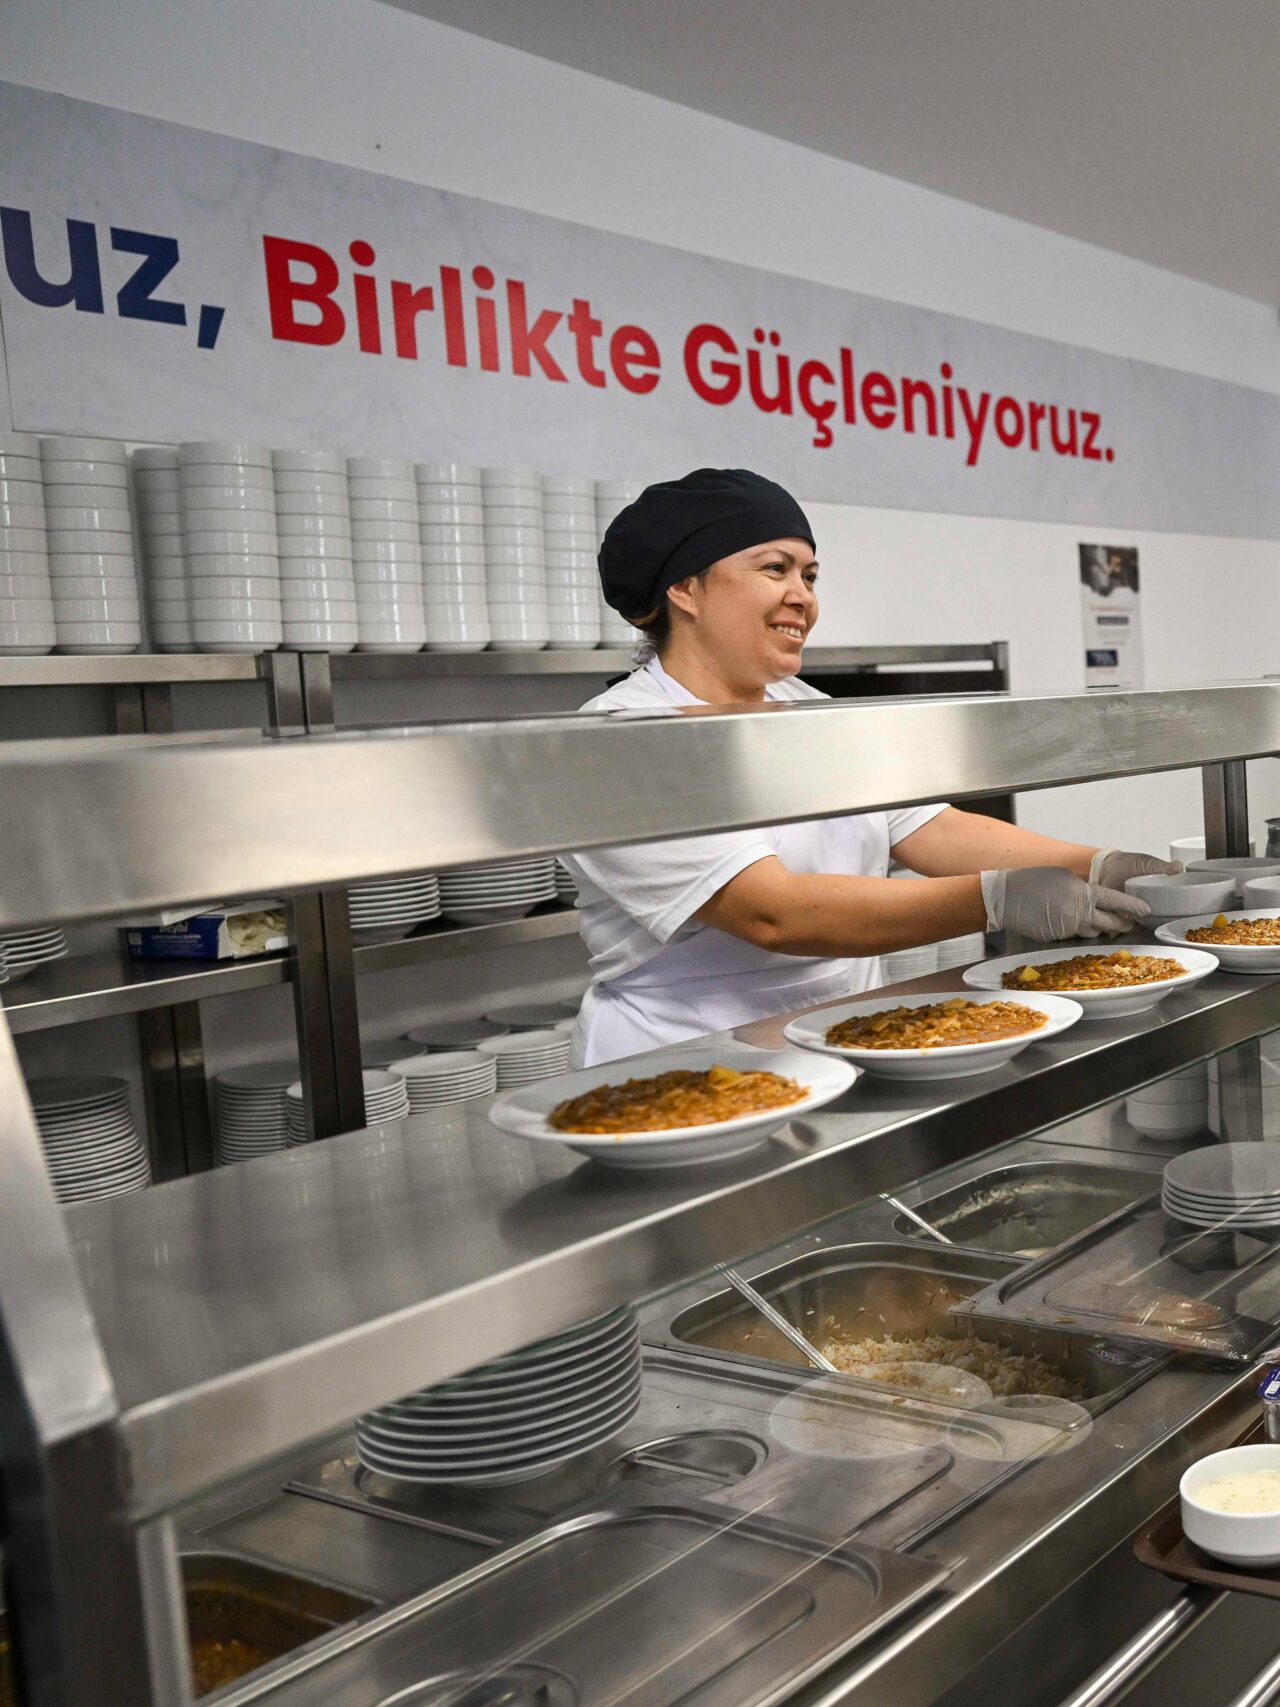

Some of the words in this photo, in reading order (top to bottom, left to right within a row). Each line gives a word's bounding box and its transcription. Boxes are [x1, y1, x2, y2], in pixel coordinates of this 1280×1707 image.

[0, 206, 225, 349] uz,
[263, 236, 661, 395] Birlikte
[684, 324, 1115, 466] Güçleniyoruz.
